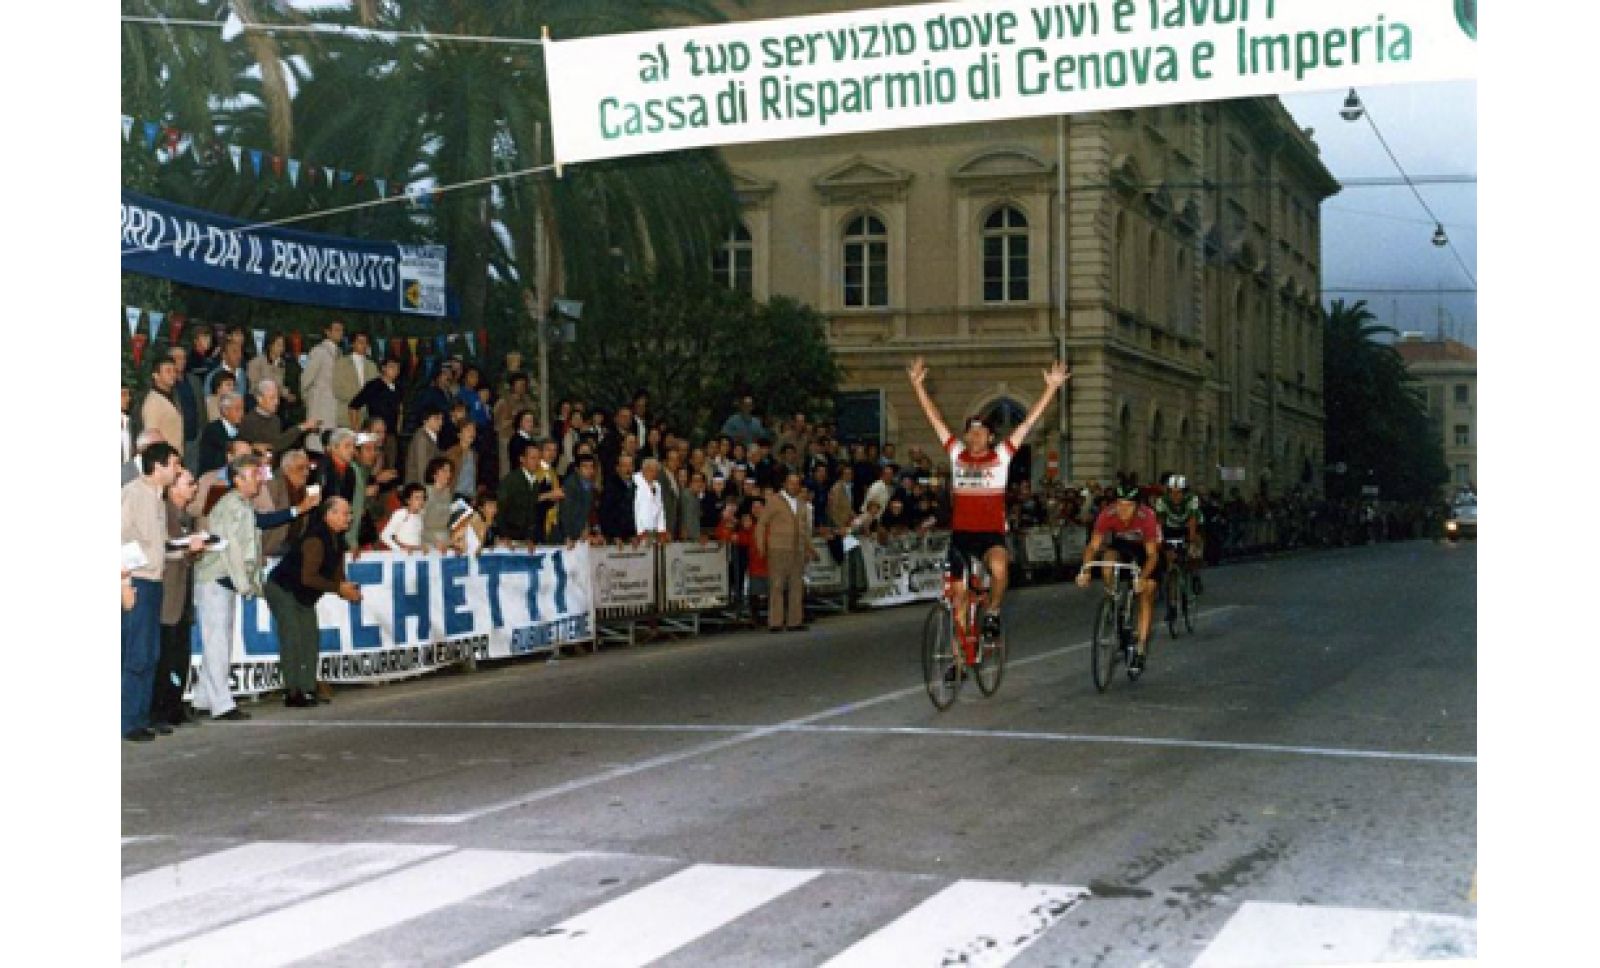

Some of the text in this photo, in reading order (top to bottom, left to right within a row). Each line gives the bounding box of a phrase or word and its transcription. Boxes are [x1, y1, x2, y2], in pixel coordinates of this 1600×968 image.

[598, 15, 1413, 140] Cassa di Risparmio di Genova e Imperia
[638, 43, 670, 84] al
[683, 39, 751, 77] tuo
[759, 22, 917, 69] servizio
[923, 10, 1019, 53] dove
[1030, 2, 1101, 42] vivi
[1111, 0, 1136, 34] e
[170, 216, 200, 260] VI
[270, 239, 395, 291] BENVENUTO
[436, 633, 490, 662] EUROPA
